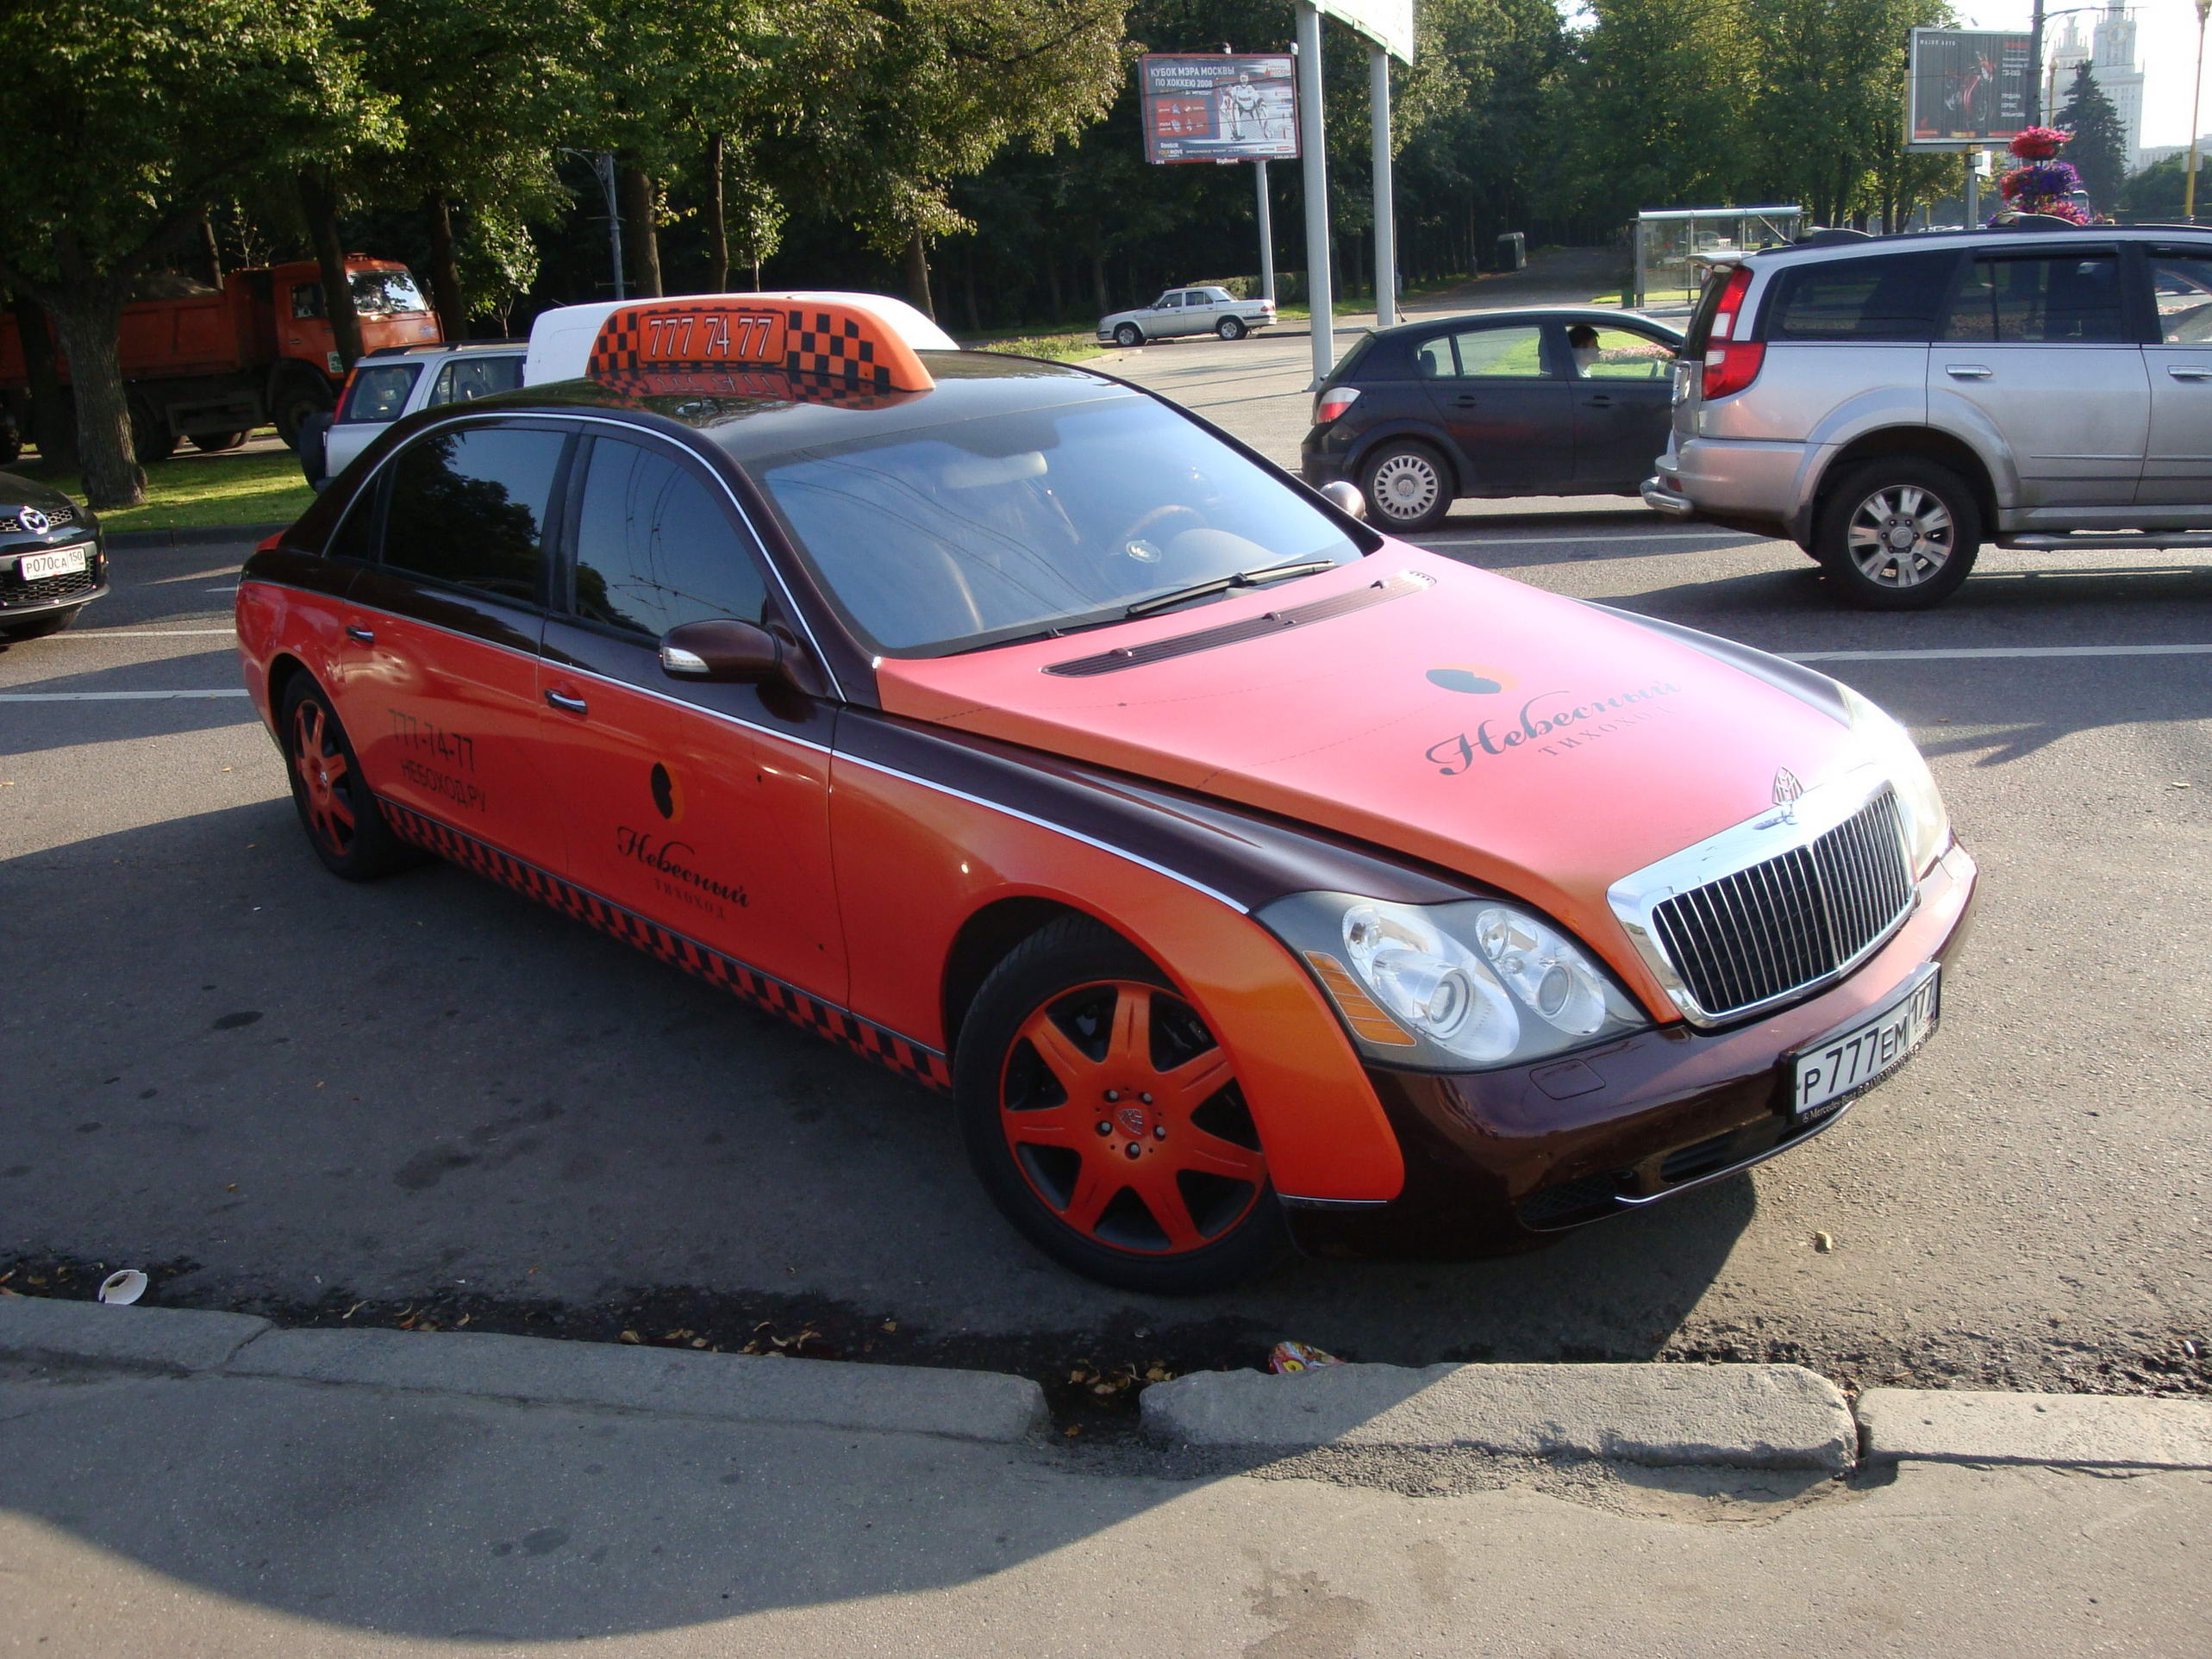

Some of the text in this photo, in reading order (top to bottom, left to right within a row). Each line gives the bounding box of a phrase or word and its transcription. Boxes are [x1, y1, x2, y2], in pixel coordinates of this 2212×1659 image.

[1150, 65, 1235, 77] КУБОК МЭРА МОСКВЫ
[1155, 78, 1213, 88] ПО ХОККЕЮ 2008
[648, 314, 774, 359] 777 74 77
[69, 551, 83, 563] 150
[387, 708, 474, 772] 777-74-77
[1425, 680, 1682, 776] Небесный
[617, 826, 749, 907] Небесный
[1911, 976, 1934, 1025] 177
